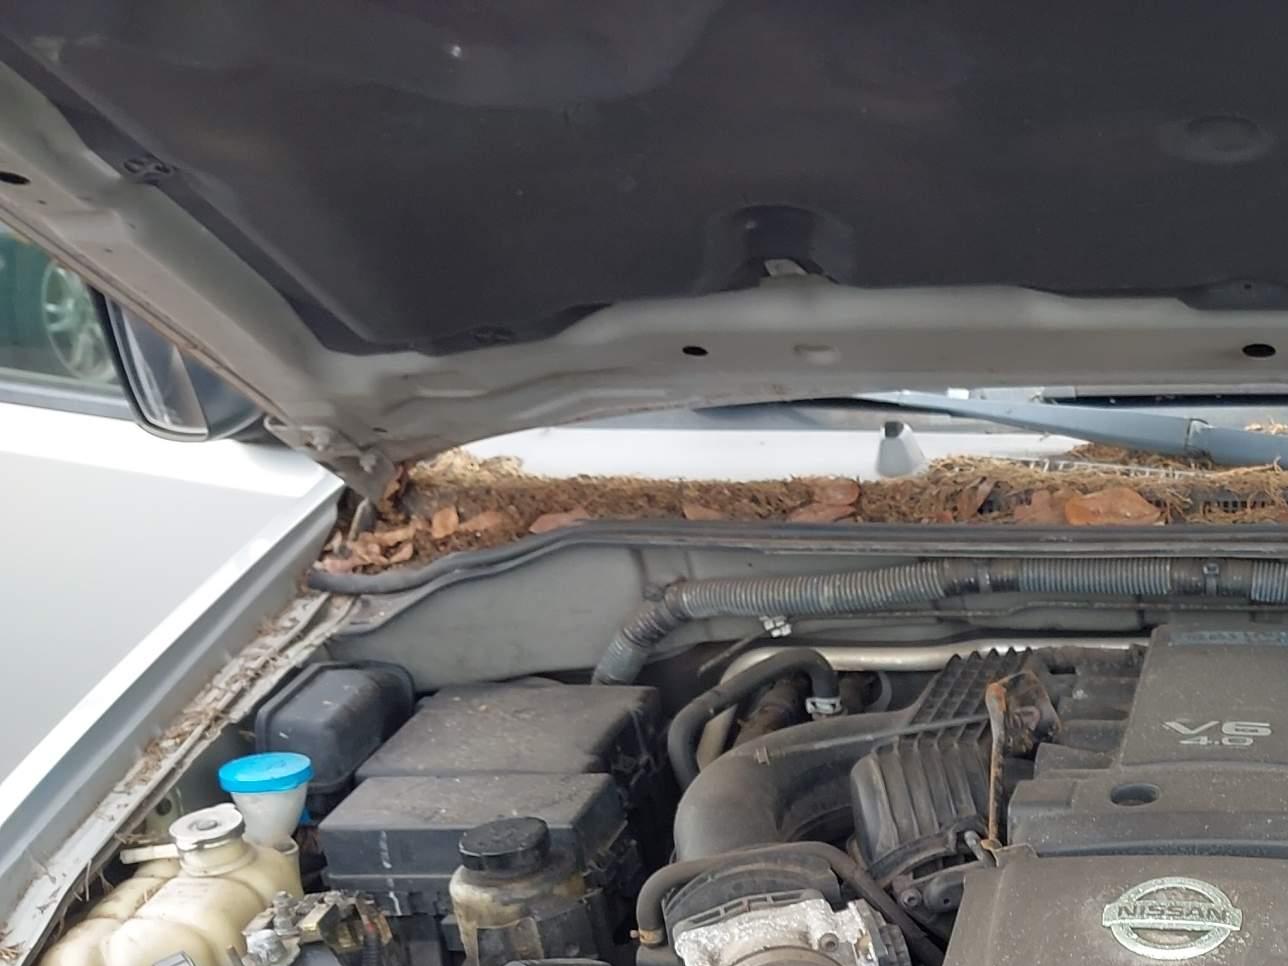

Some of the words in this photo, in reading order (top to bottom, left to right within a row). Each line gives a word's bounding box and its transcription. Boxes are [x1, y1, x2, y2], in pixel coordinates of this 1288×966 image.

[1161, 720, 1272, 736] V6
[1179, 735, 1254, 746] 4.0
[1118, 903, 1228, 922] NISSAN
